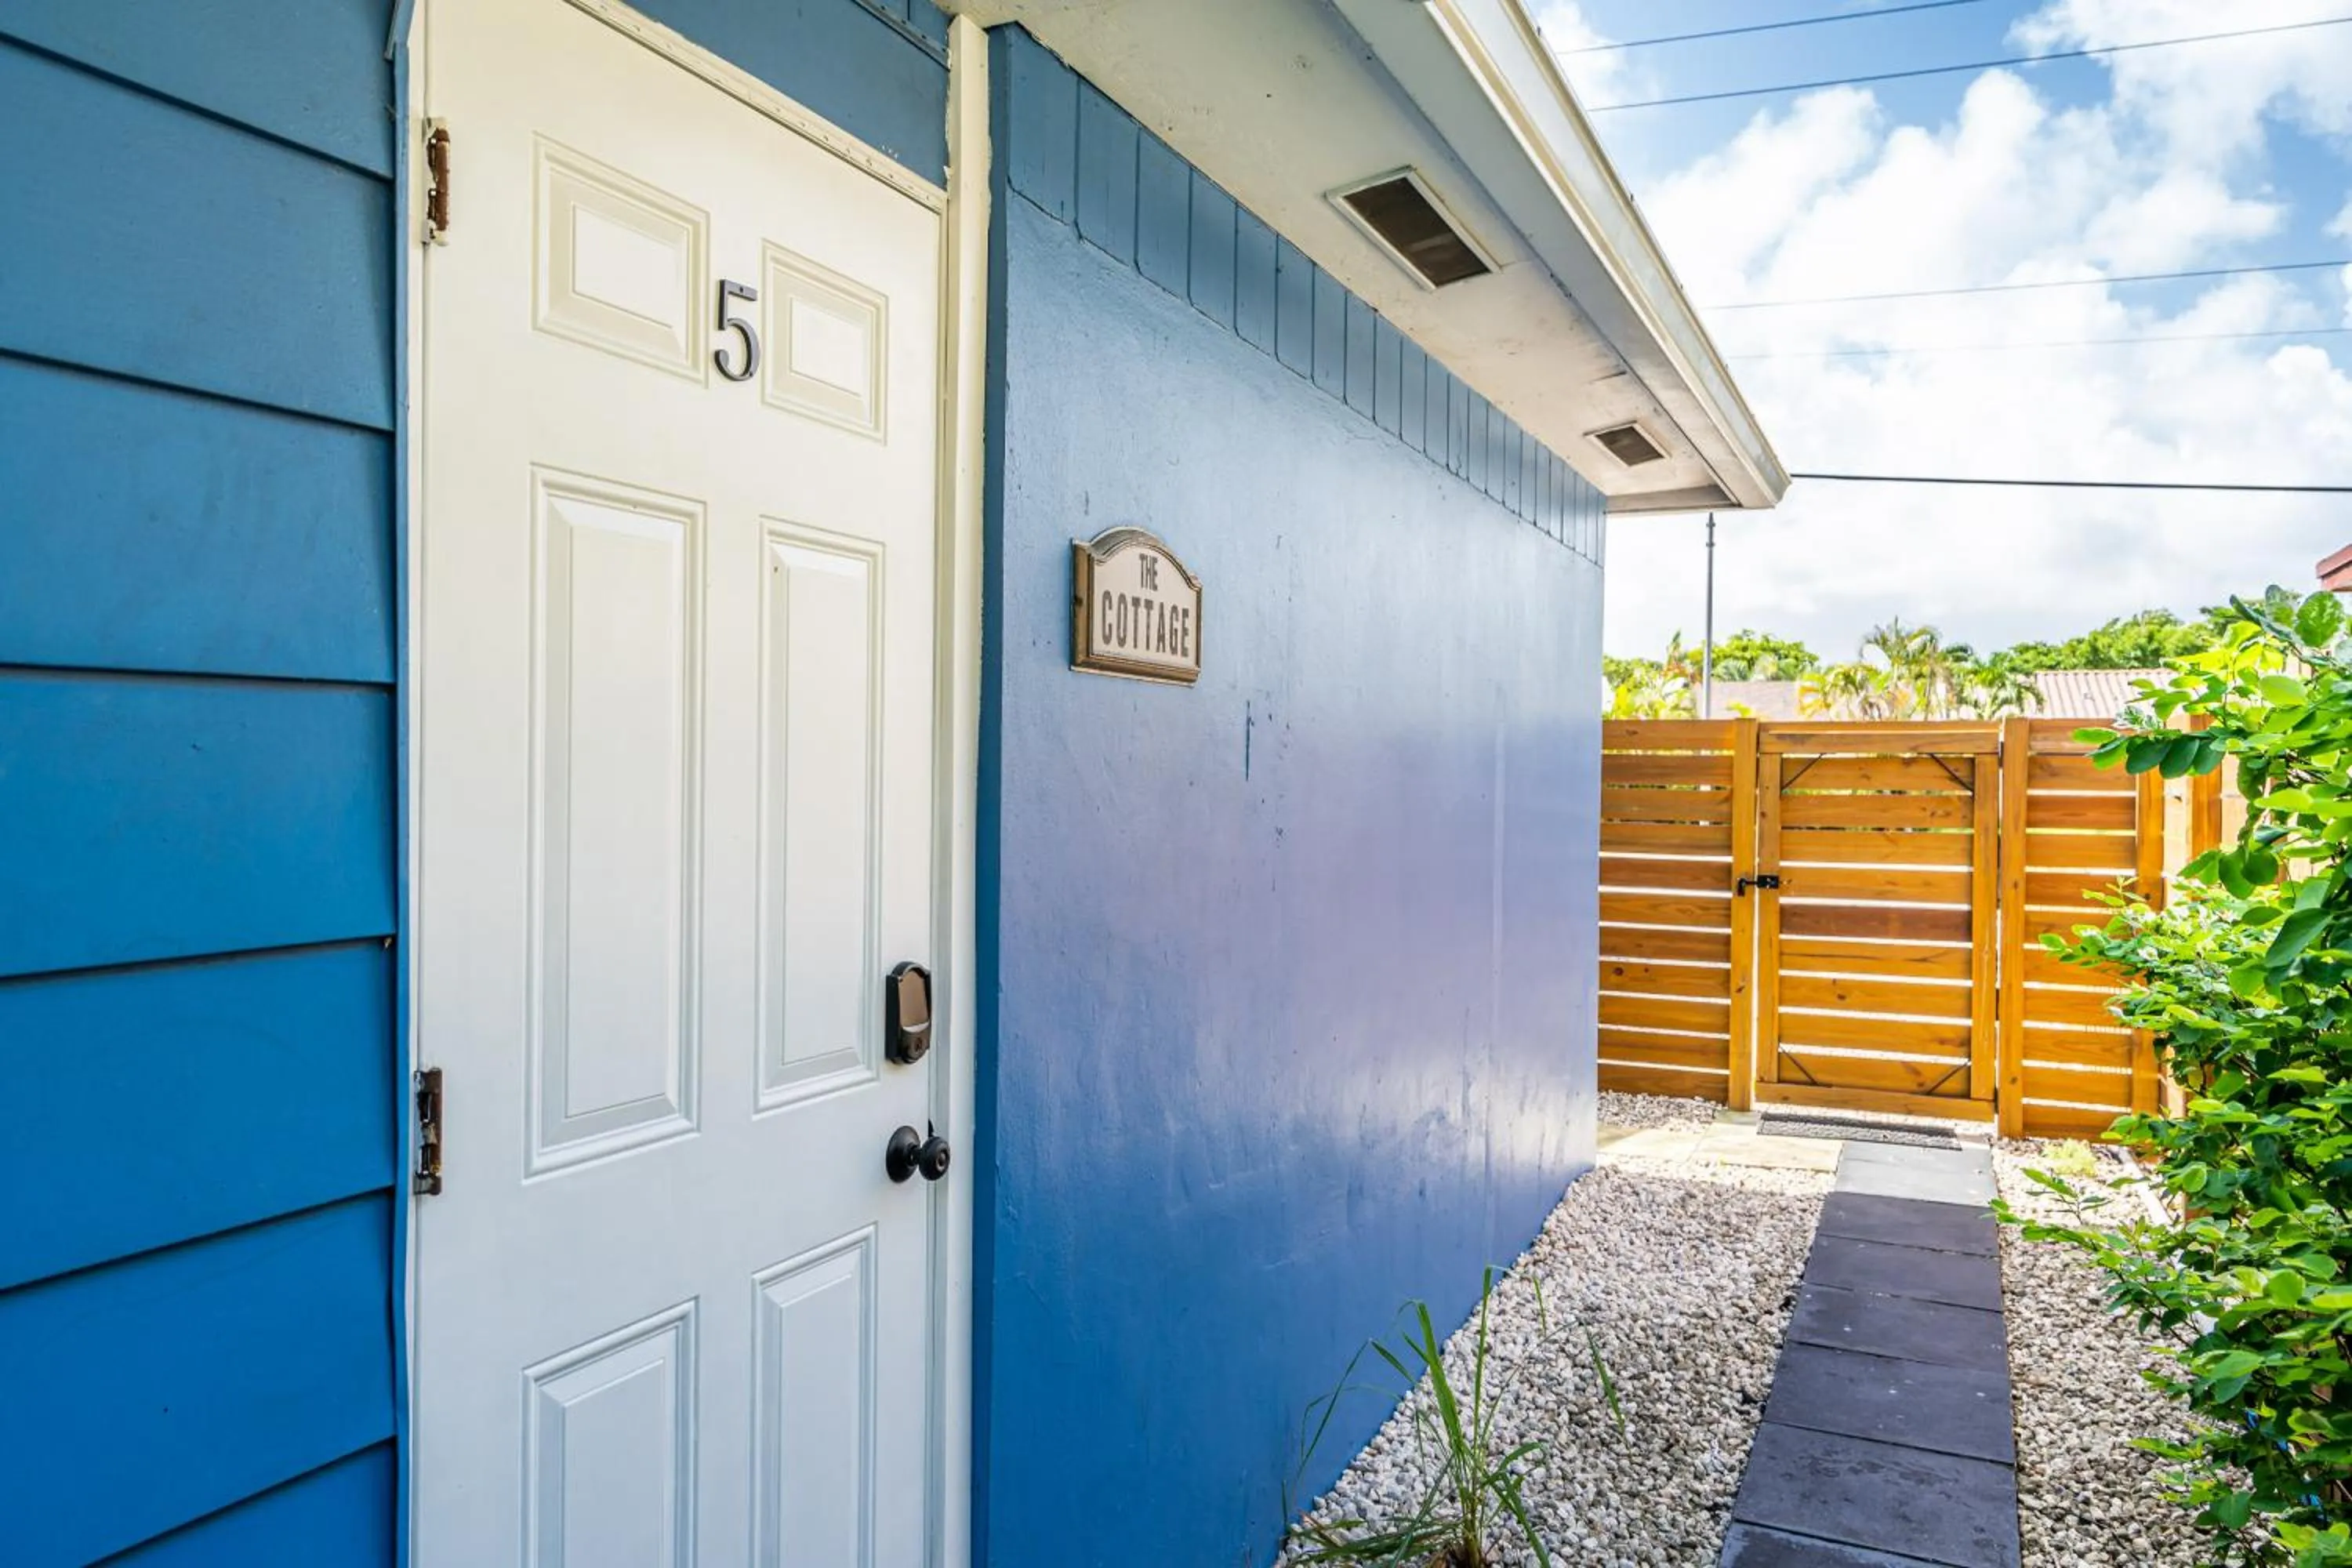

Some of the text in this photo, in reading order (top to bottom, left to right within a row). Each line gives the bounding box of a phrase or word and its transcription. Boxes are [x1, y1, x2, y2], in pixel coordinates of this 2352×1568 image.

[714, 279, 760, 381] 5
[1139, 554, 1158, 591] THE
[1102, 590, 1189, 657] COTTAGE
